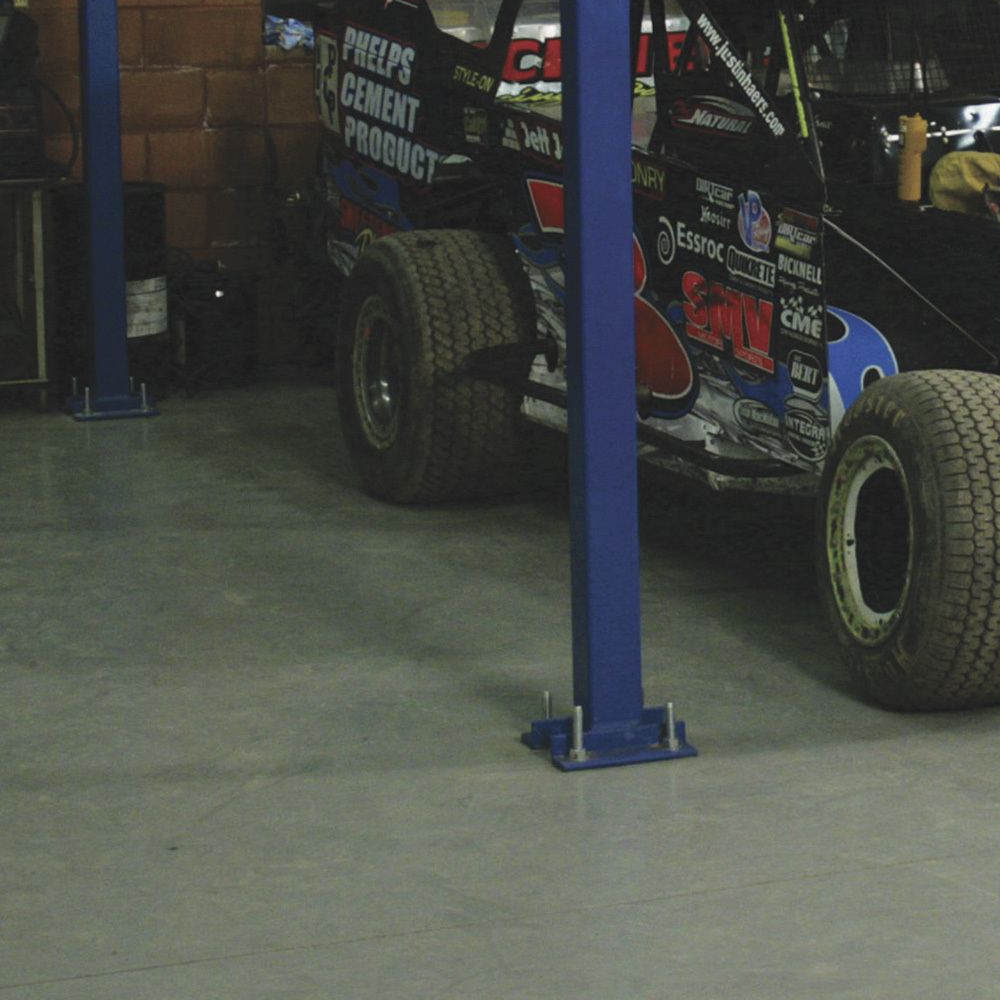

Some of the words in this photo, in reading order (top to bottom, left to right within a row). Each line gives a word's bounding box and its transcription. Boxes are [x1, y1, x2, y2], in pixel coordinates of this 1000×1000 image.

[342, 25, 416, 86] PHELPS
[696, 12, 785, 137] www.justinhaers.com
[341, 70, 421, 134] CEMENT
[676, 108, 752, 134] NATURAL
[676, 221, 724, 263] Essroc
[778, 253, 823, 285] BICKNELL
[780, 310, 823, 339] CME
